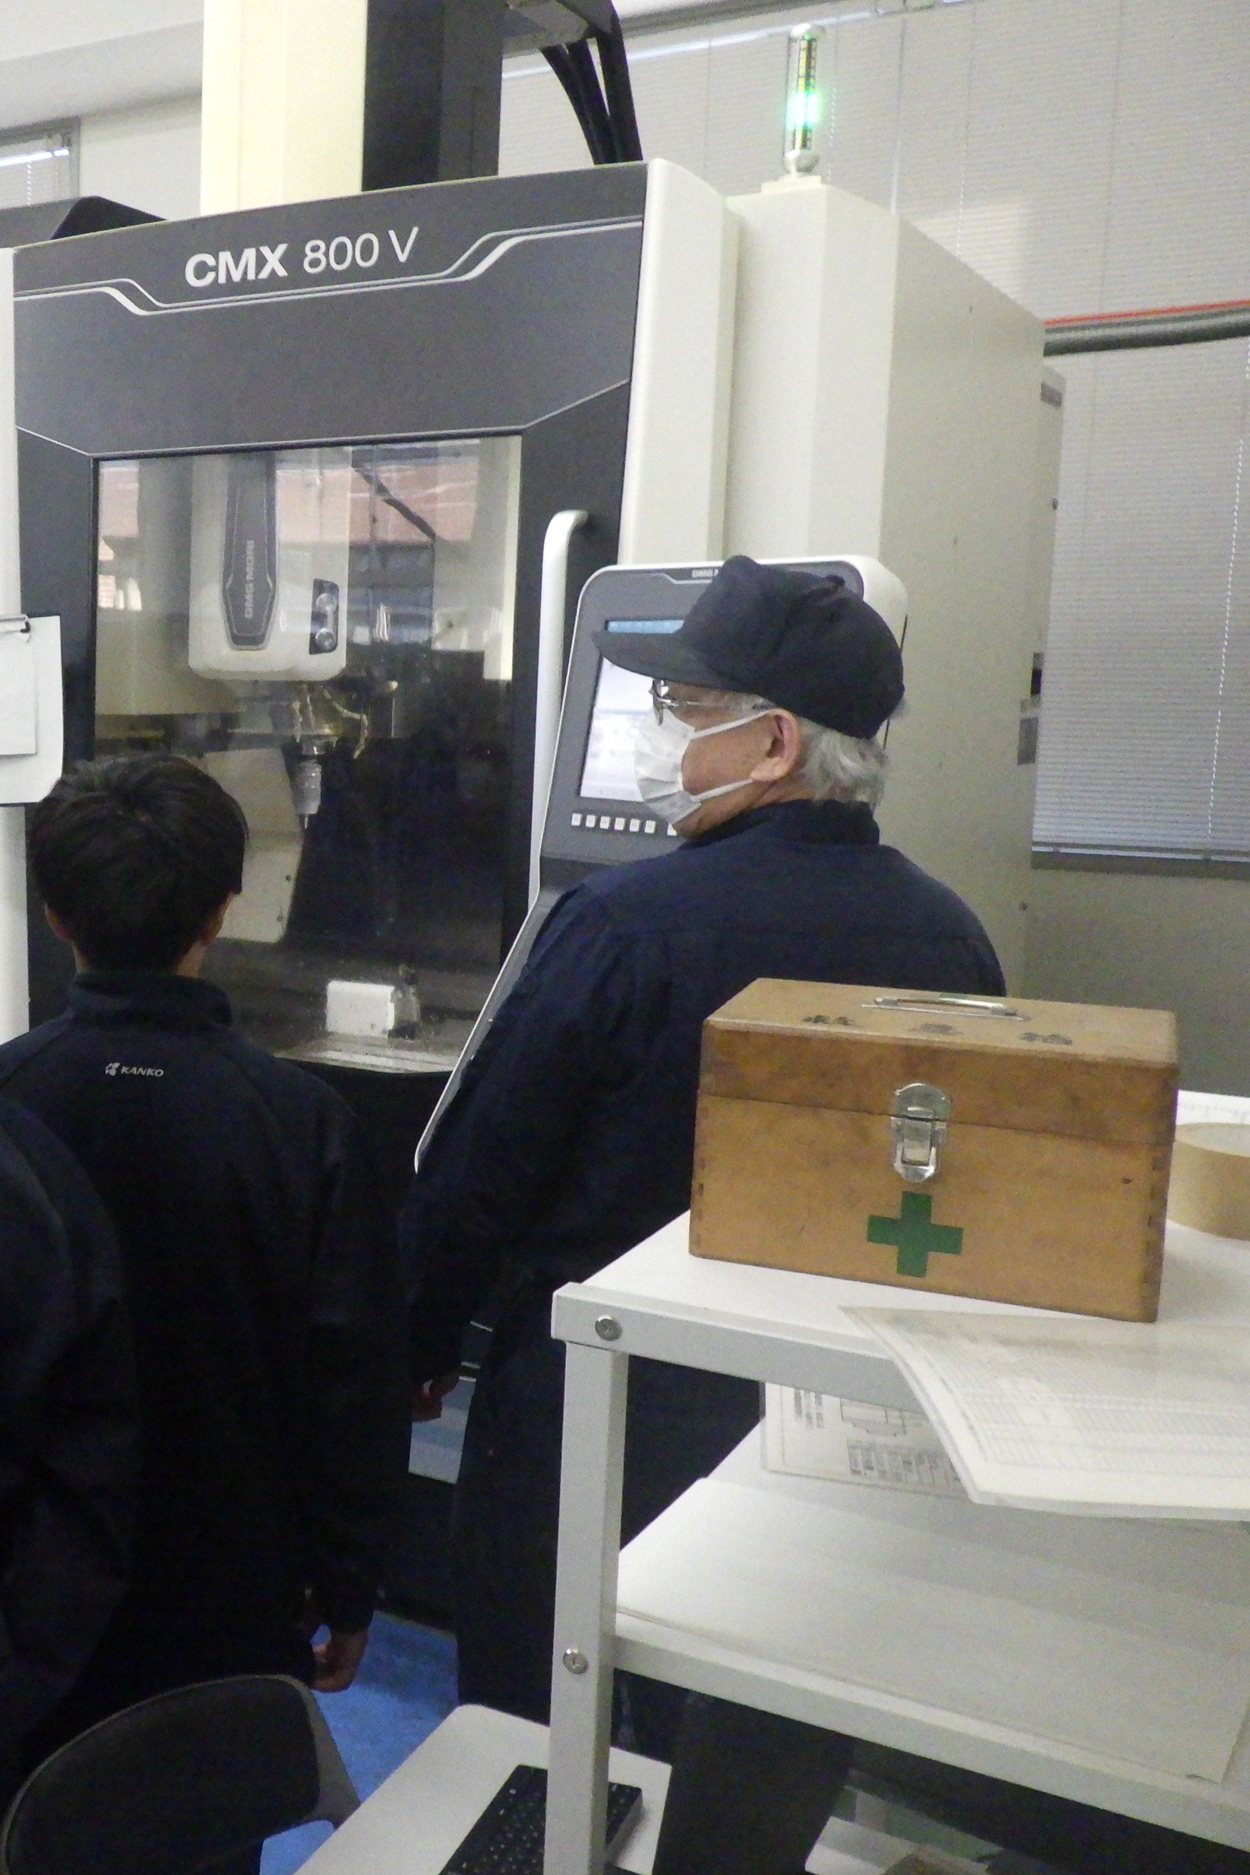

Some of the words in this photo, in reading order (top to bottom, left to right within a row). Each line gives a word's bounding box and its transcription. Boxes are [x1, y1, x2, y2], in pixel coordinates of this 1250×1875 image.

[184, 243, 288, 288] CMX
[303, 232, 380, 274] 800
[387, 226, 419, 263] V
[120, 1066, 164, 1077] KANKO
